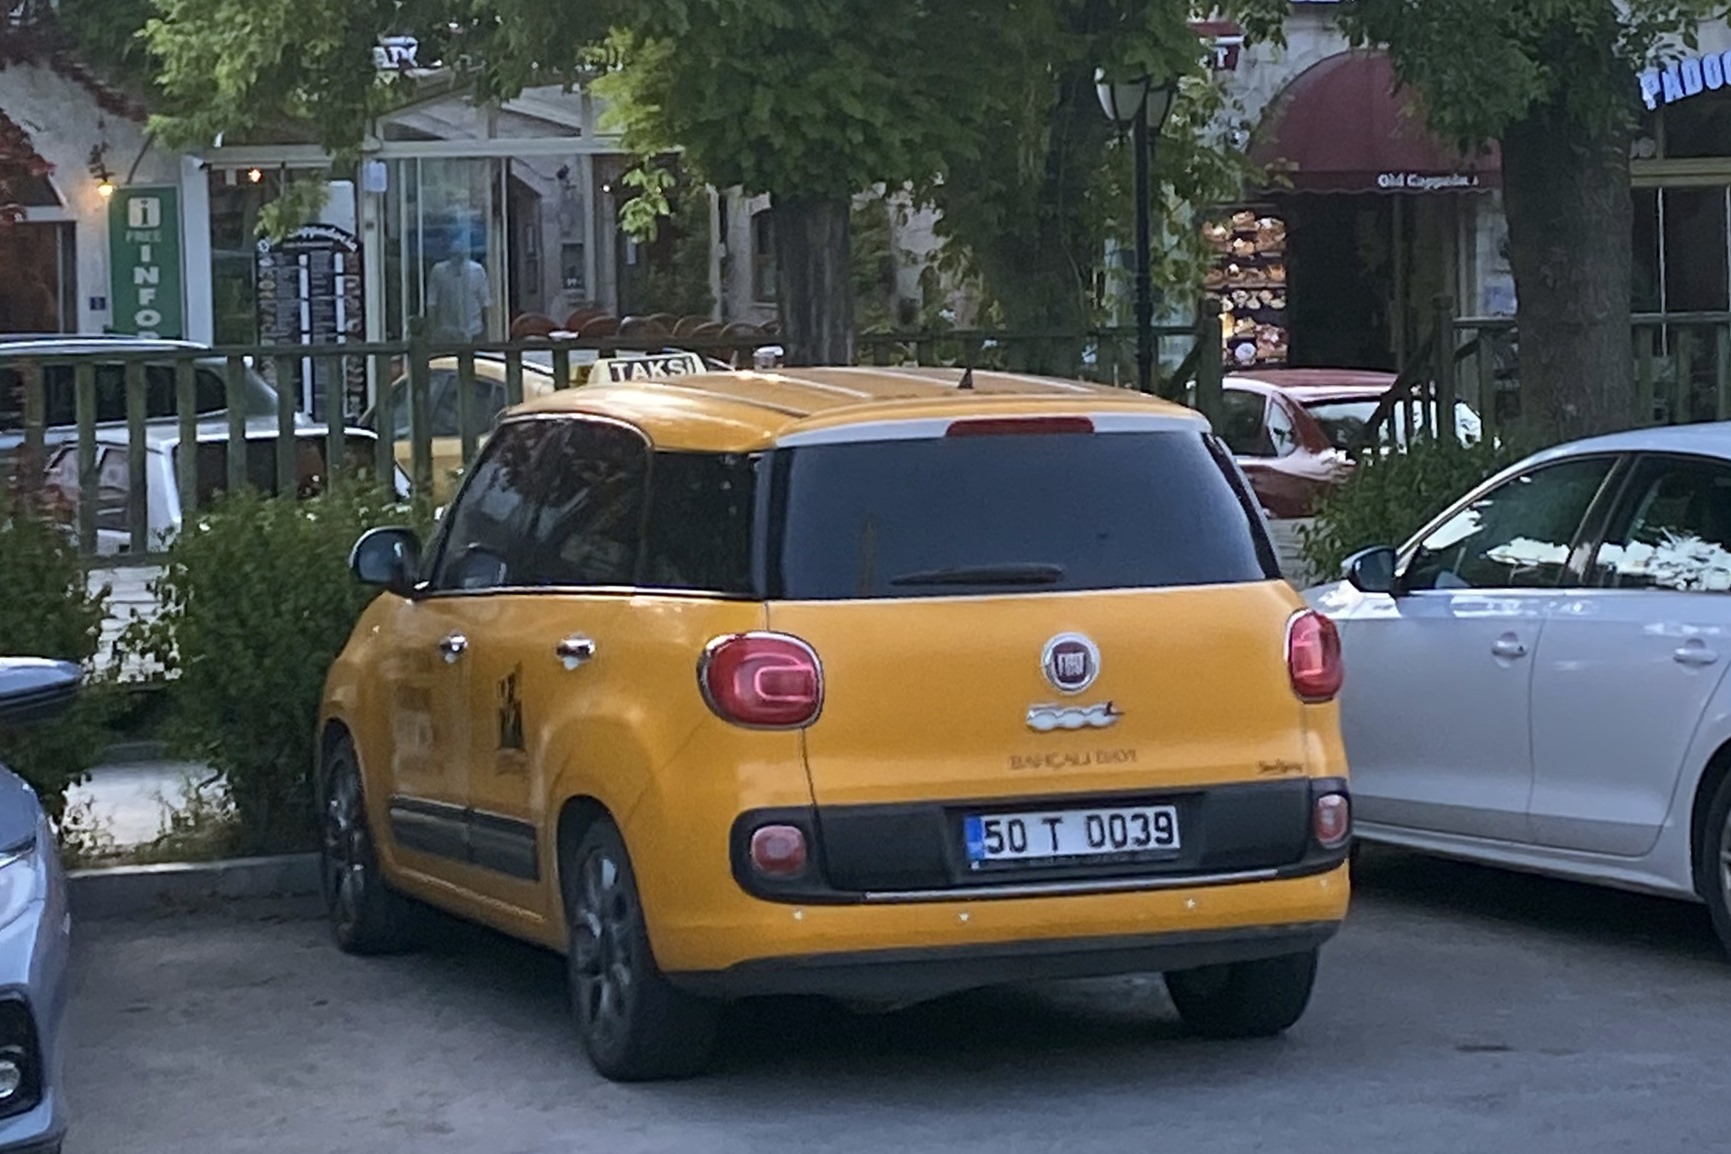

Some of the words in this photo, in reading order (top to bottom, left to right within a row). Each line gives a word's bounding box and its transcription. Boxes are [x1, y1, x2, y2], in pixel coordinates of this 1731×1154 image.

[1378, 173, 1404, 187] Old
[984, 819, 1026, 853] 50
[1042, 817, 1063, 852] T
[1086, 811, 1173, 849] 0039
